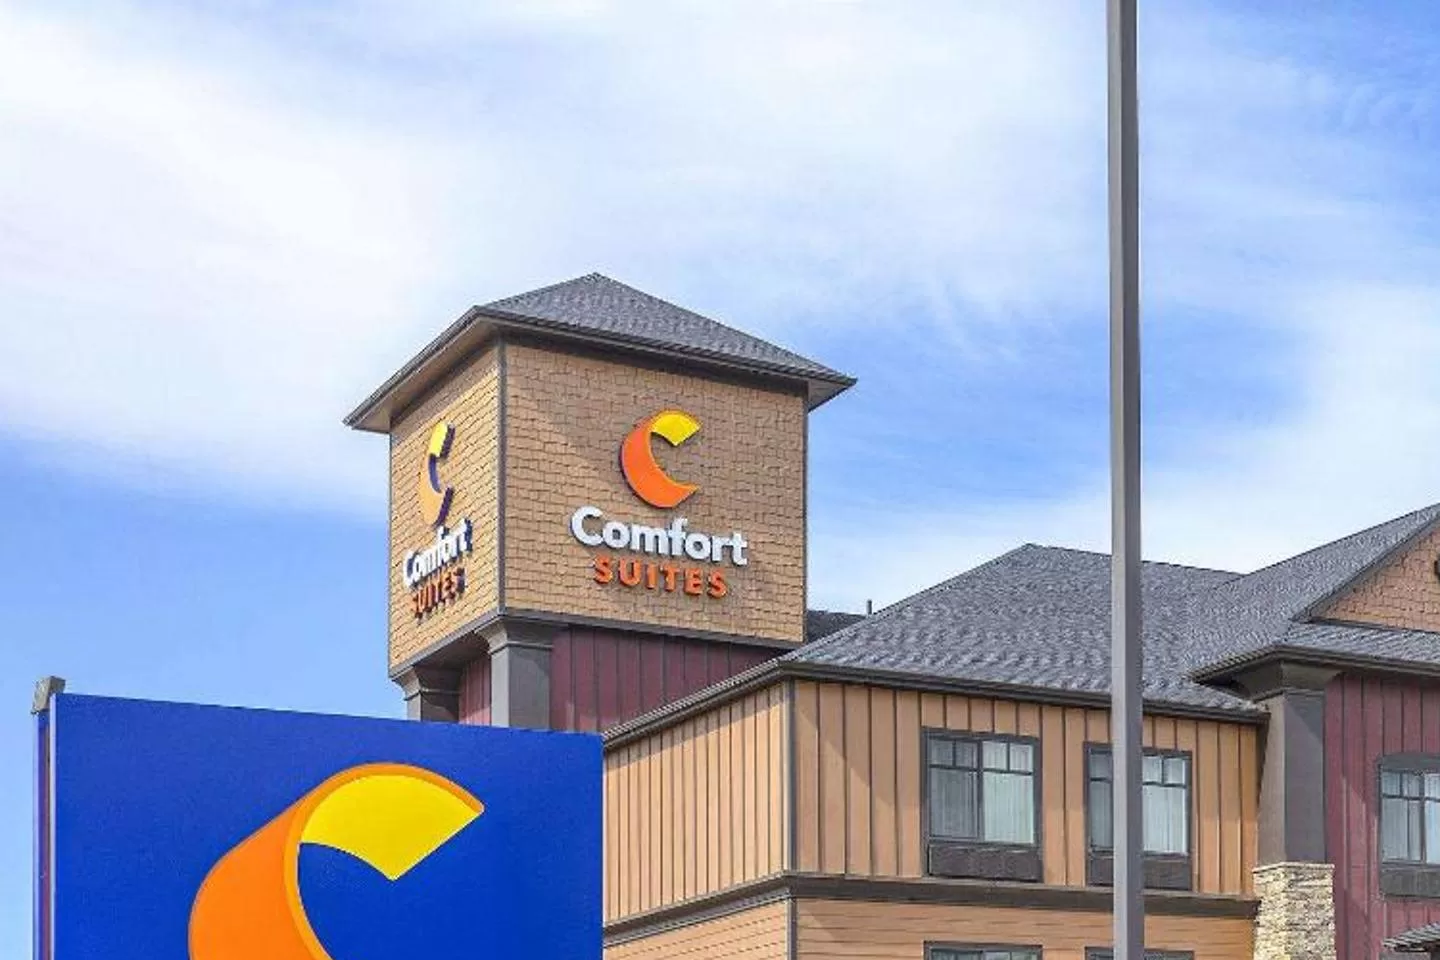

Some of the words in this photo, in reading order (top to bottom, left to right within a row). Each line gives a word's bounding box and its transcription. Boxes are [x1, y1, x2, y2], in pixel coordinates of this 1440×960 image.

[403, 518, 472, 589] Comfort
[571, 506, 748, 566] Comfort
[593, 556, 728, 598] SUITES
